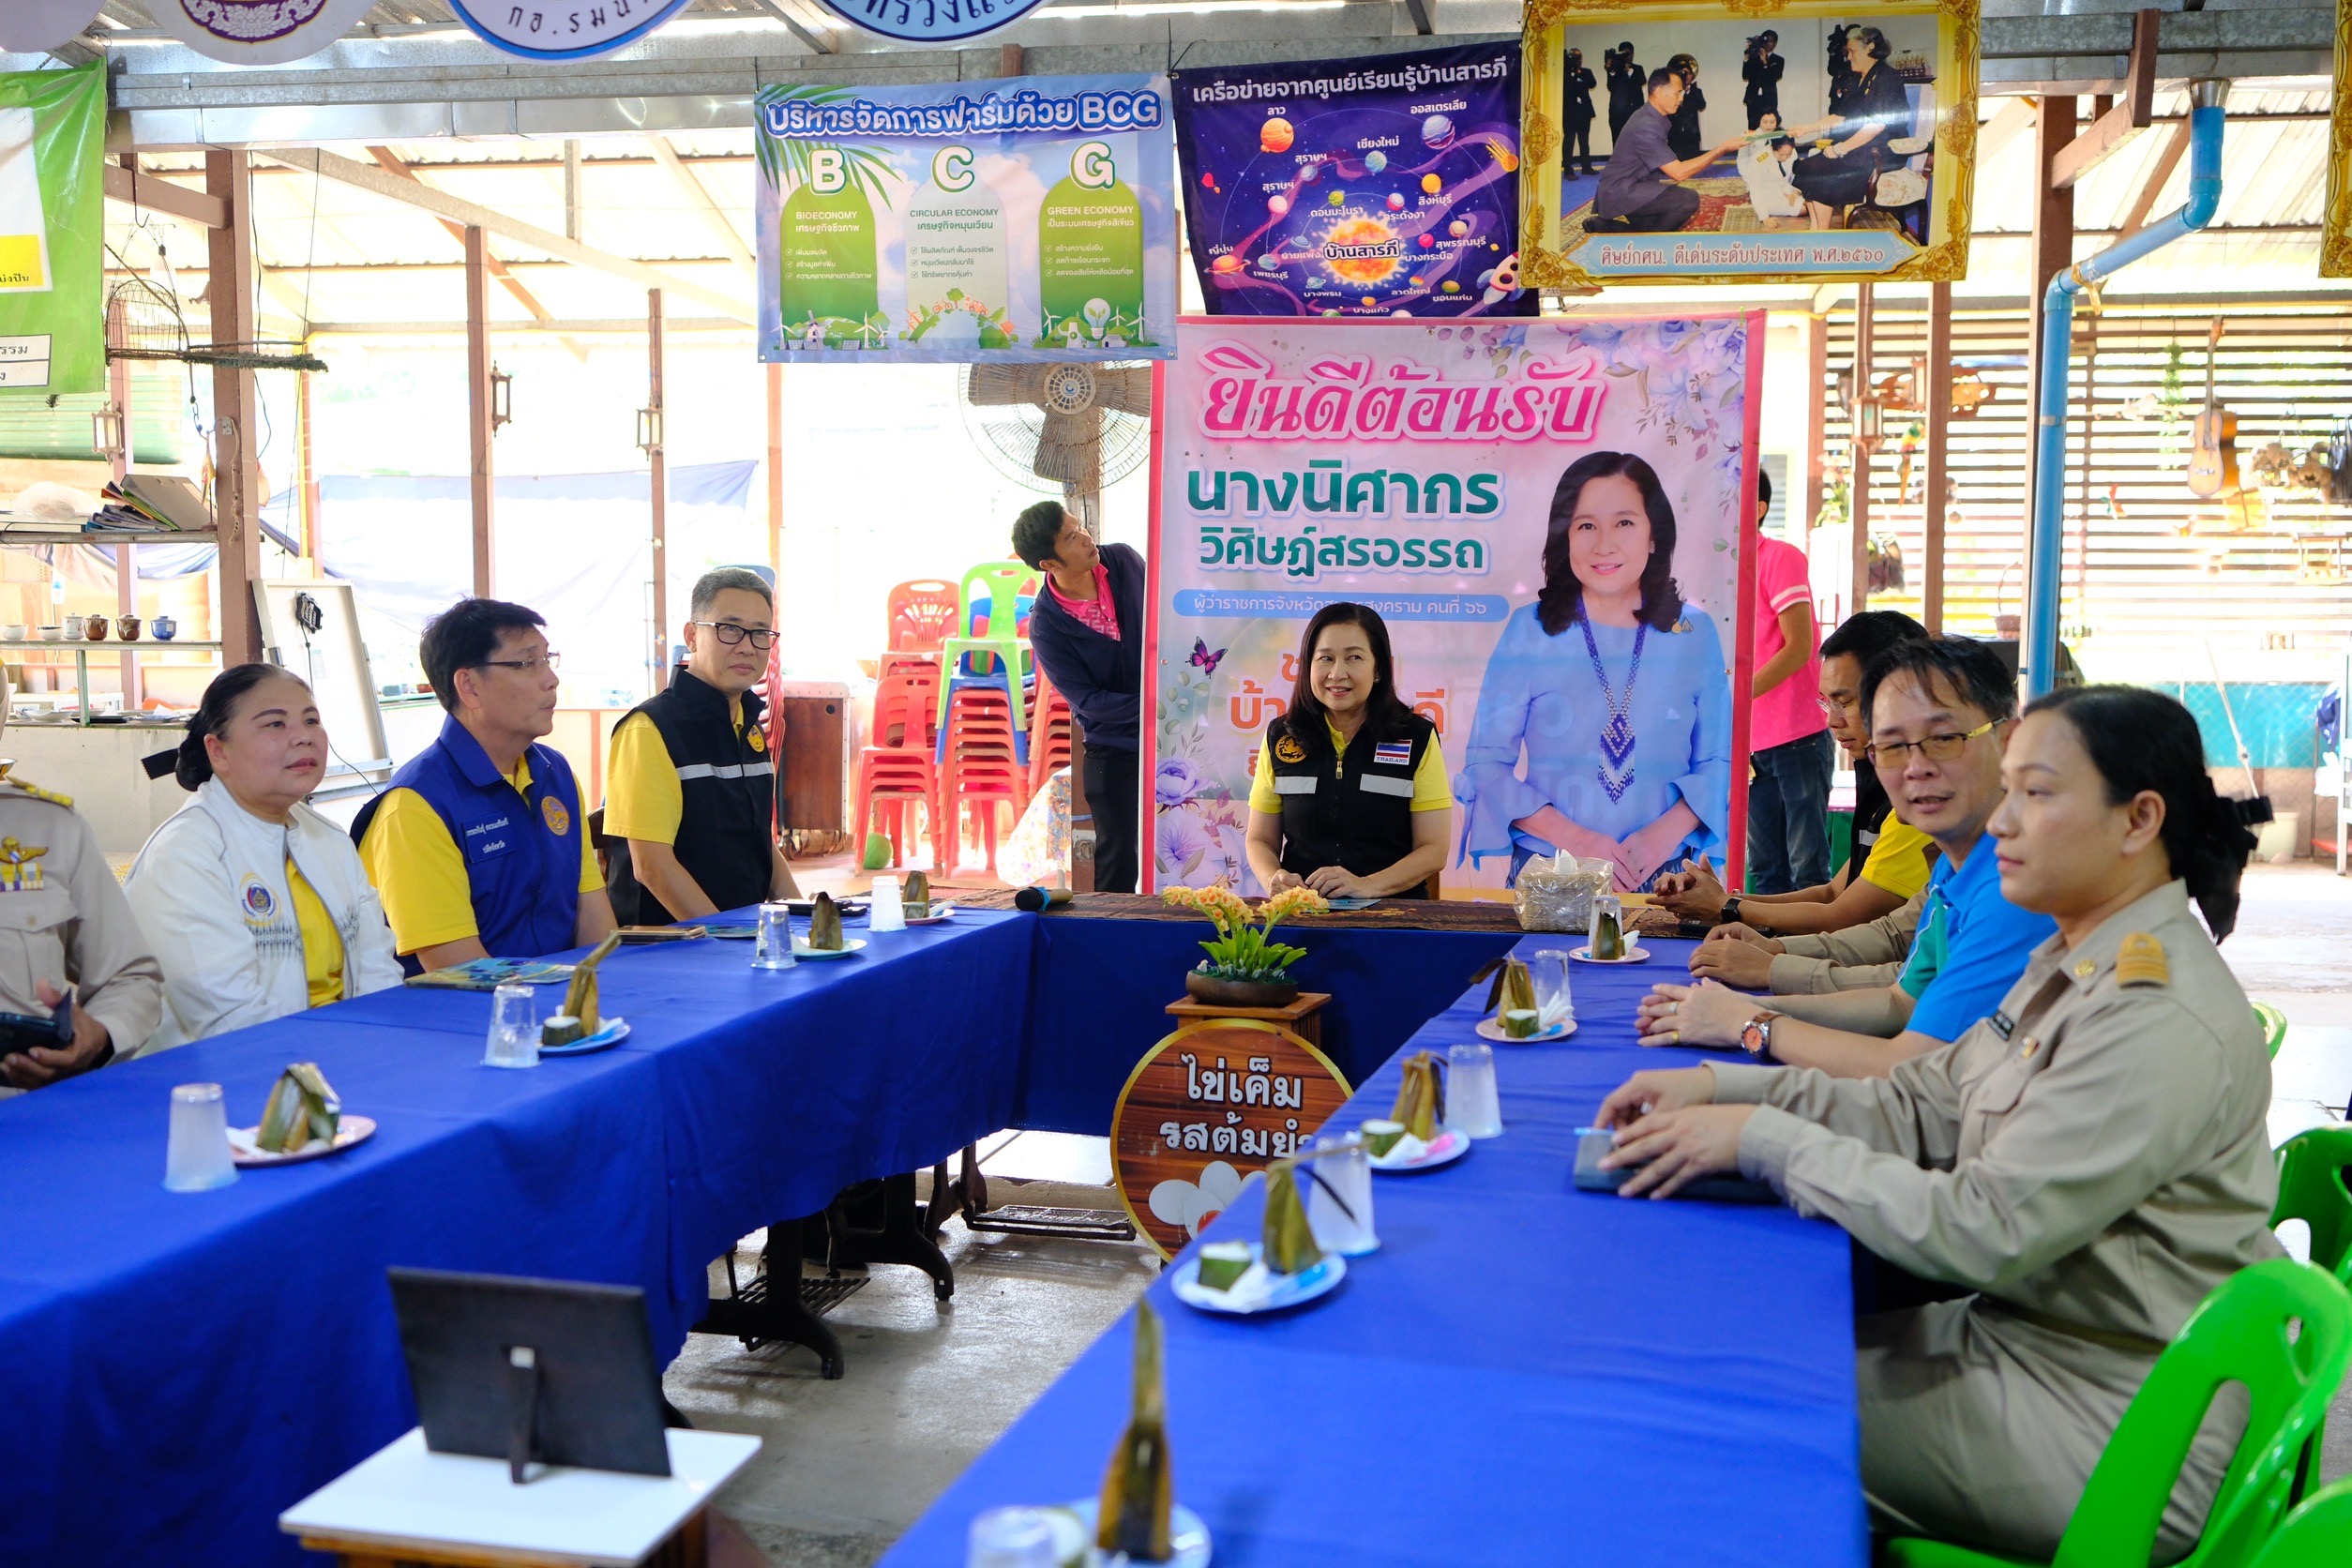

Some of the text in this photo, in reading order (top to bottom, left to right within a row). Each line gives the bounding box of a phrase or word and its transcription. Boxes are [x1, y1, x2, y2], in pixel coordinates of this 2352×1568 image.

[1193, 55, 1508, 102] เครือข่ายจากศูนย์เรียนรู้บ้านสารภี
[769, 92, 1159, 131] บริหารจัดการฟาร์มด้วย BCG
[1267, 105, 1286, 115] ลาว
[1410, 99, 1467, 113] ออสเตรเลีย
[1357, 135, 1399, 149] เชียงใหม่
[808, 149, 846, 194] B
[931, 145, 975, 193] C
[1070, 141, 1115, 189] G
[1418, 193, 1453, 206] สิงห์บุรี
[795, 211, 858, 220] BIOECONOMY
[910, 208, 999, 218] CIRCULAR ECONOMY
[1047, 205, 1134, 215] GREEN ECONOMY
[917, 219, 994, 232] เศรษฐกิจหมุนเวียน
[1324, 238, 1400, 260] บ้านสารภี
[1435, 235, 1486, 249] สุพรรณบุรี
[1208, 244, 1234, 255] ญี่ปุ่น
[1601, 242, 1884, 265] ศิษย์กศน. ดีเด่นระดับประเทศ พ.ศ.๒๕๖๐
[1203, 345, 1602, 434] ยินดีต้อนรับ
[1187, 460, 1499, 514] นางนิศากร
[1427, 600, 1460, 614] คนที่
[1376, 756, 1408, 764] THAILAND
[1181, 1053, 1302, 1108] ไข่เค็ม
